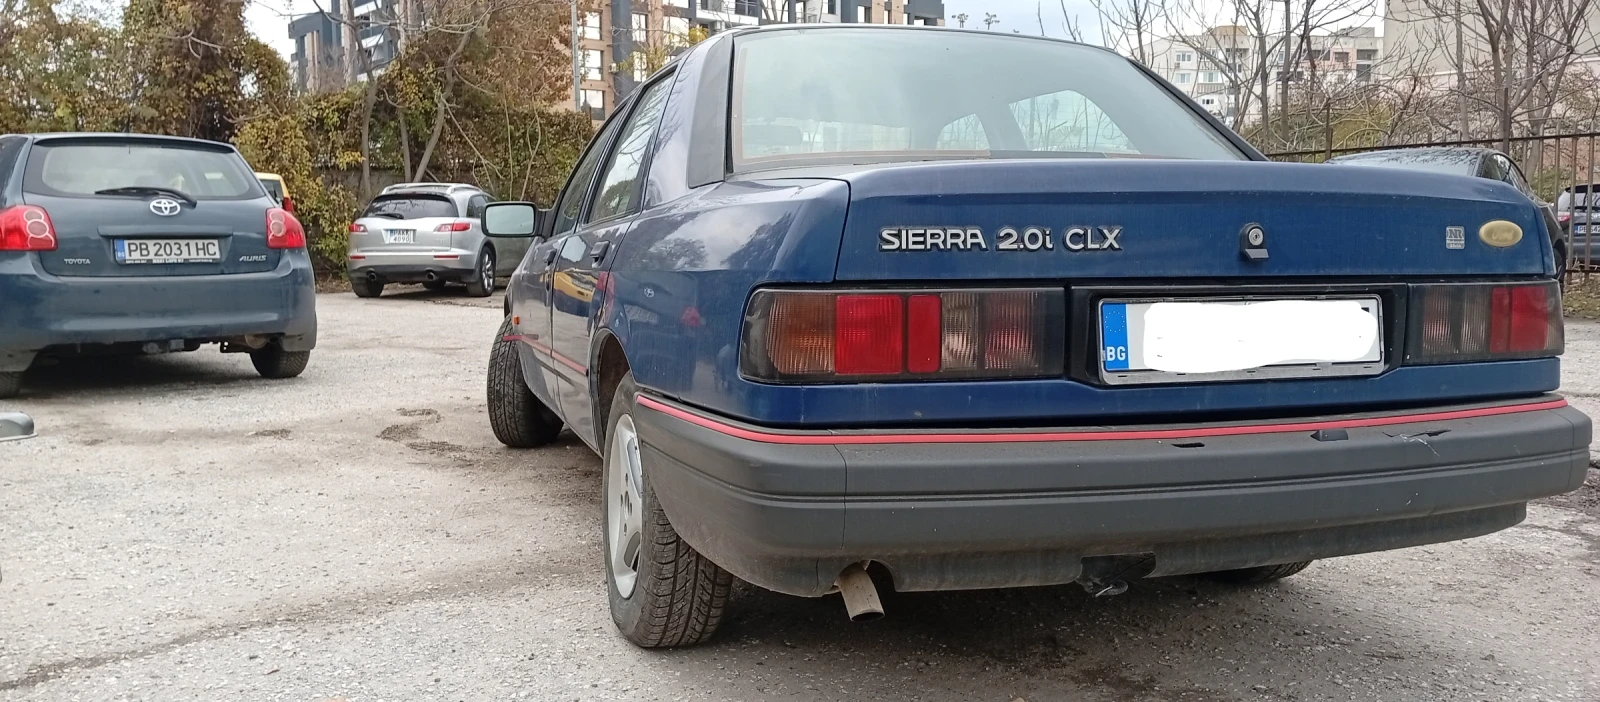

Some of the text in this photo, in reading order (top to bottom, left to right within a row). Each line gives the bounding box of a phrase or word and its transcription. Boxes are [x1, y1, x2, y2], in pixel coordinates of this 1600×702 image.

[880, 227, 1122, 250] SIERRA 2.0i CLX
[127, 241, 217, 258] PB 2031 HC
[238, 254, 267, 262] AURIS
[1106, 345, 1127, 362] BG
